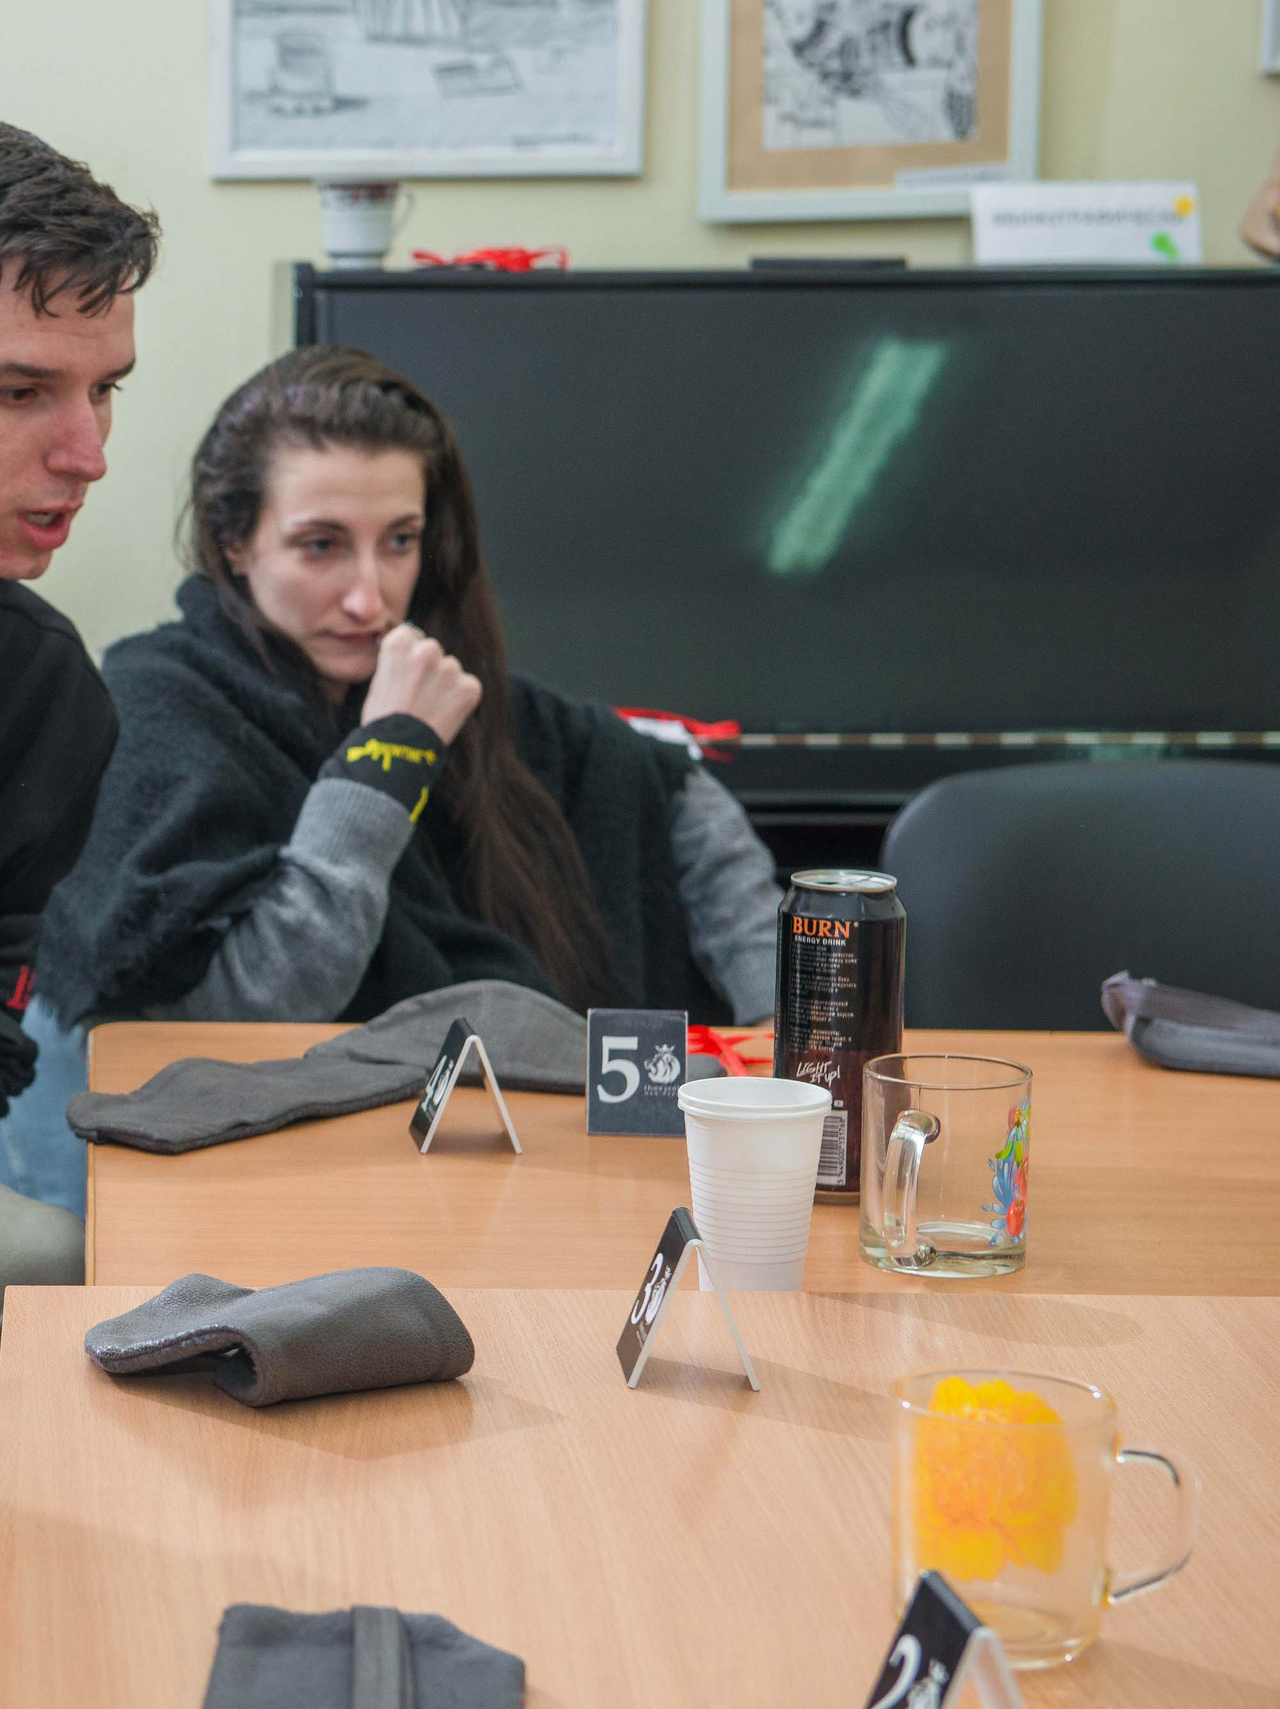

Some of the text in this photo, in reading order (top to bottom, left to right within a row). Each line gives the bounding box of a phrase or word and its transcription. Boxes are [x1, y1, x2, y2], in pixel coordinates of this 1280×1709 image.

[792, 916, 851, 939] BURN
[794, 934, 847, 947] ENERGY DRINK
[421, 1054, 447, 1112] 4
[596, 1035, 640, 1103] 5
[630, 1252, 664, 1325] 3
[869, 1633, 923, 1709] 2
